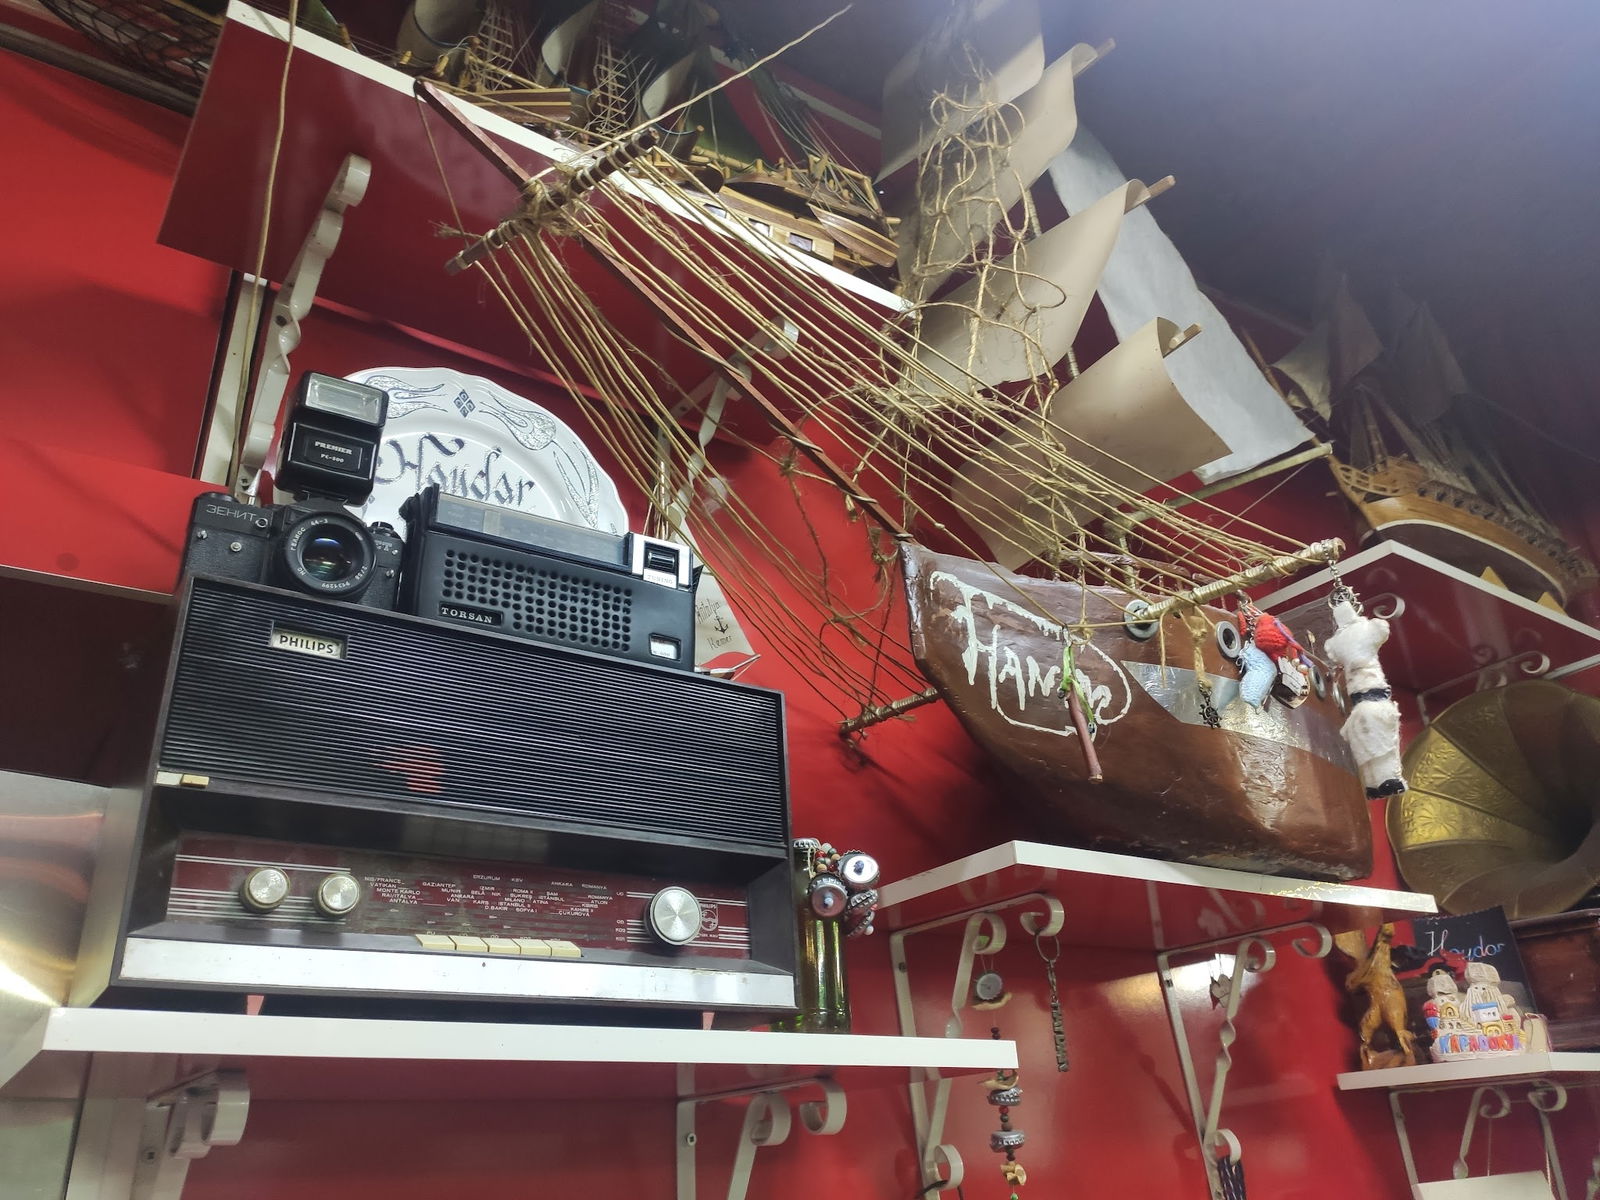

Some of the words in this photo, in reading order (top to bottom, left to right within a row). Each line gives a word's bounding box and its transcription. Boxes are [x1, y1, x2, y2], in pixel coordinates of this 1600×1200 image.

[314, 441, 353, 455] PREMIER
[206, 503, 257, 521] ЗЕНИТ
[441, 607, 493, 624] TORSAN
[279, 634, 334, 654] PHILIPS
